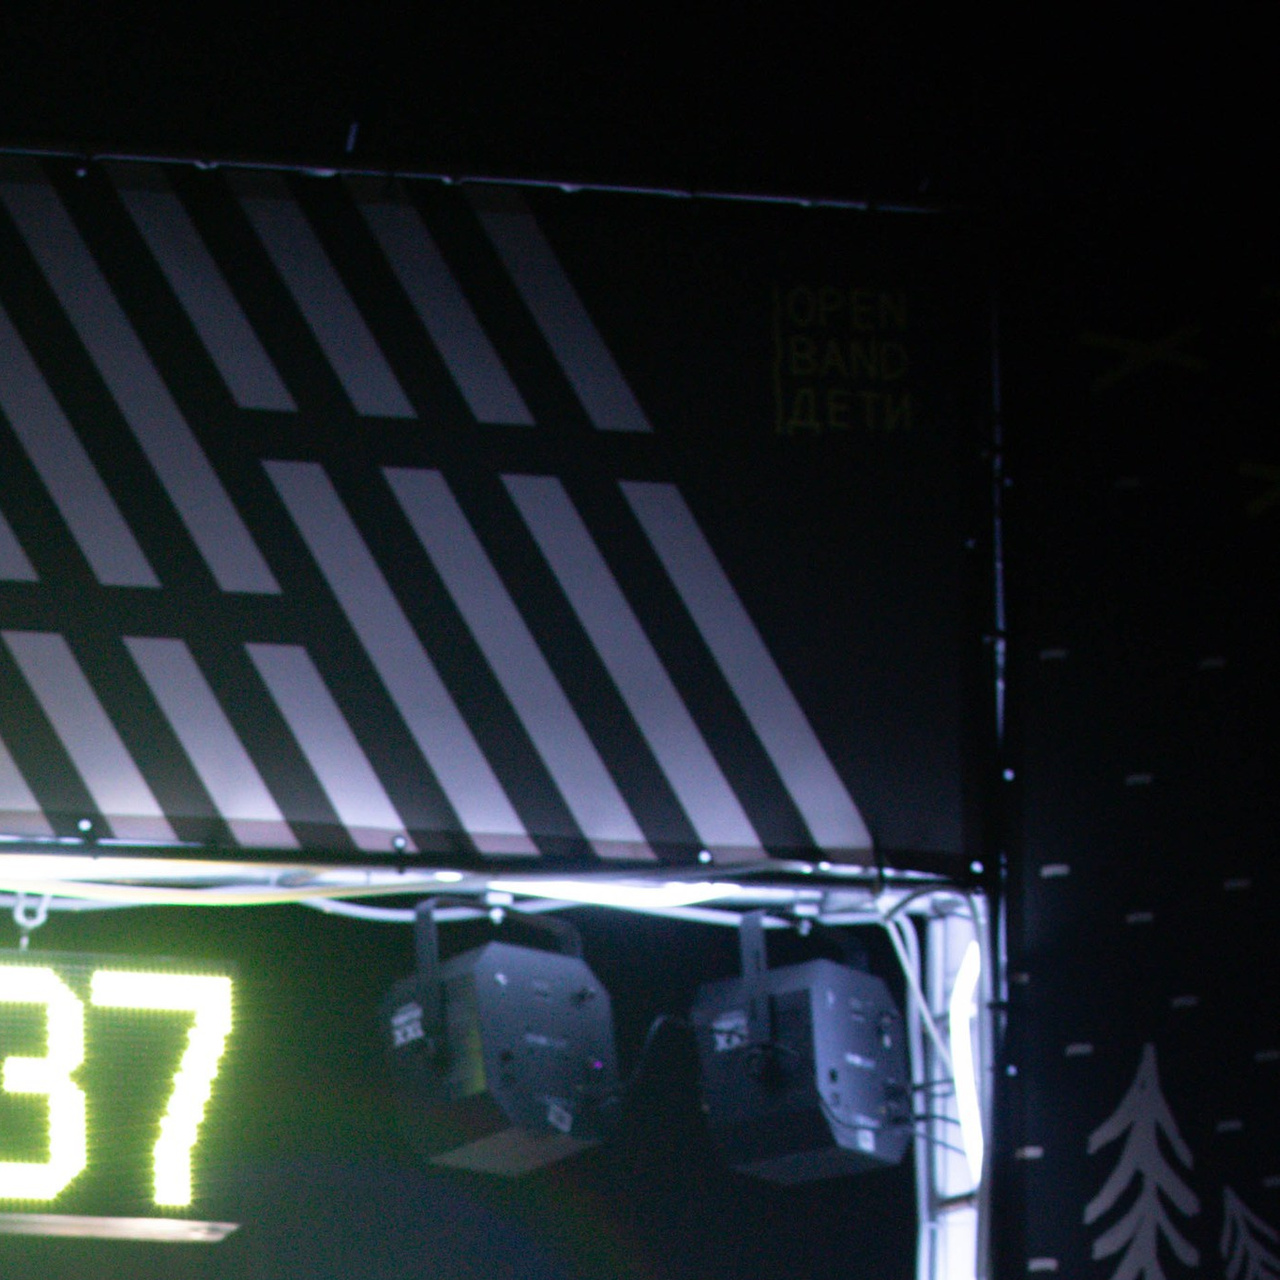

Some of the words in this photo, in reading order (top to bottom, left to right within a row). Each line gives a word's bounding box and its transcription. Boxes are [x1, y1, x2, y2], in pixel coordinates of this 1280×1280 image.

[787, 284, 908, 331] OPEN
[789, 335, 911, 381] BAND
[785, 387, 912, 436] ДЕТИ
